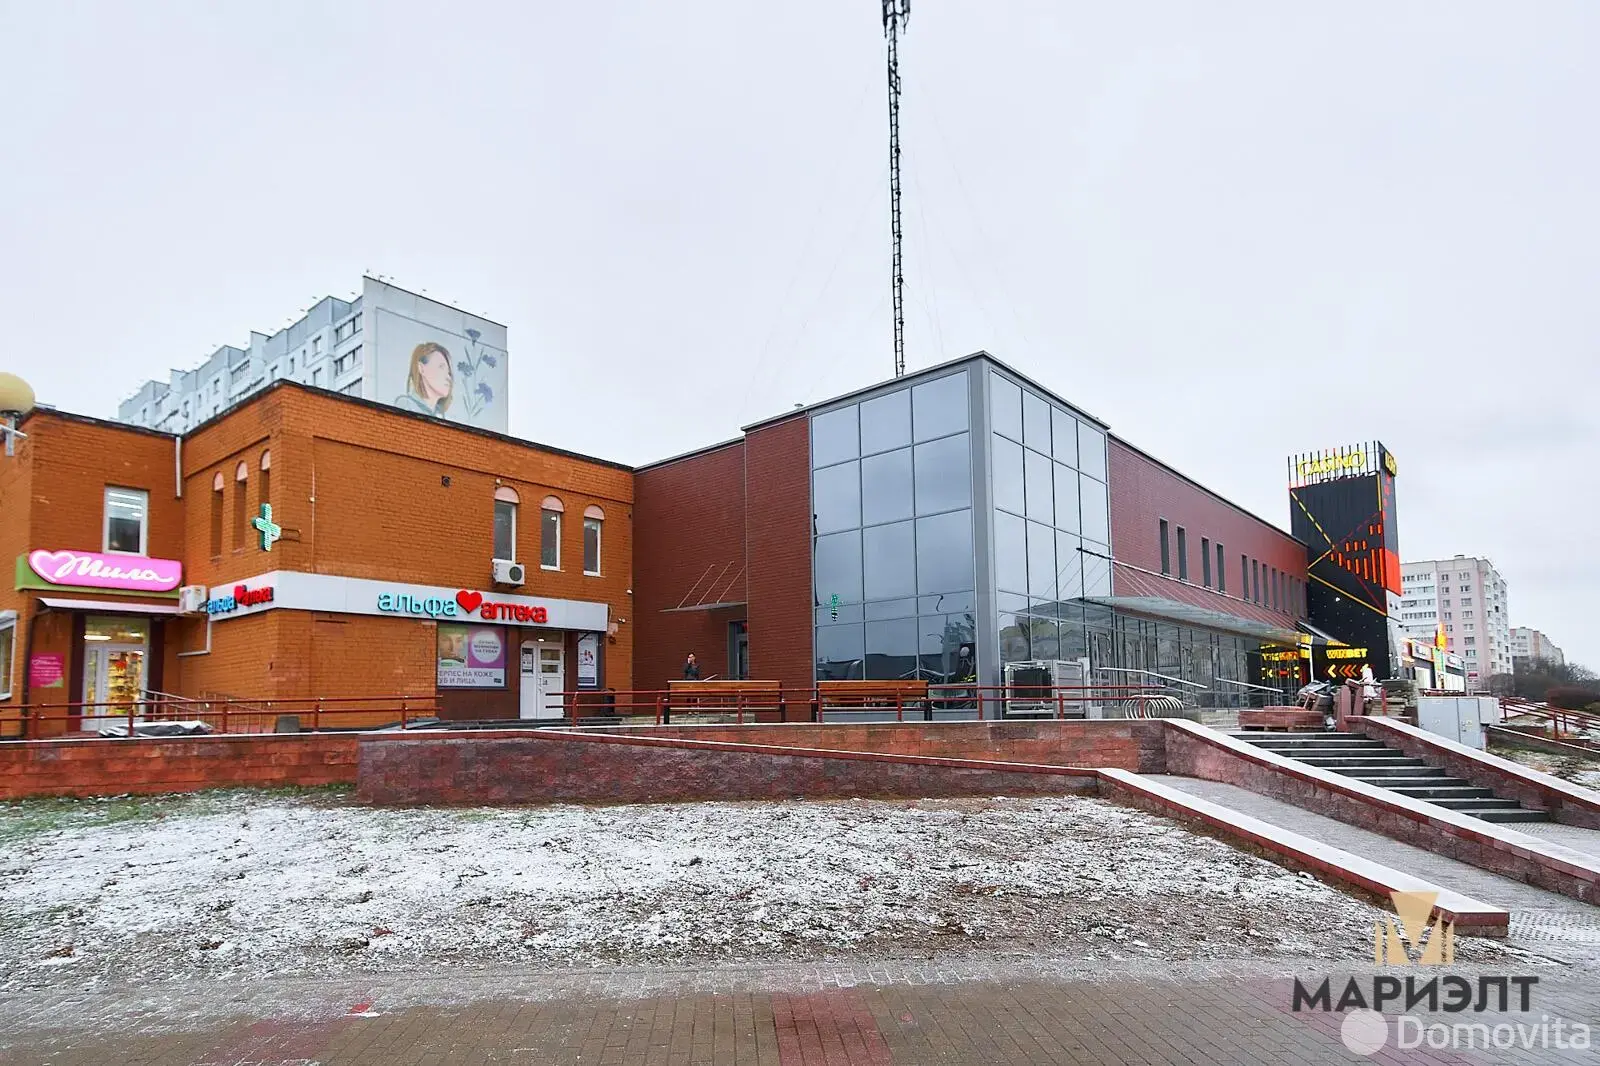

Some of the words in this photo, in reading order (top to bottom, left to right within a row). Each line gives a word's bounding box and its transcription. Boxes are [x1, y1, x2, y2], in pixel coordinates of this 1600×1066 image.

[1297, 451, 1365, 476] CASINO
[54, 556, 174, 582] Мила
[378, 592, 457, 617] альфа
[480, 602, 548, 624] аптека
